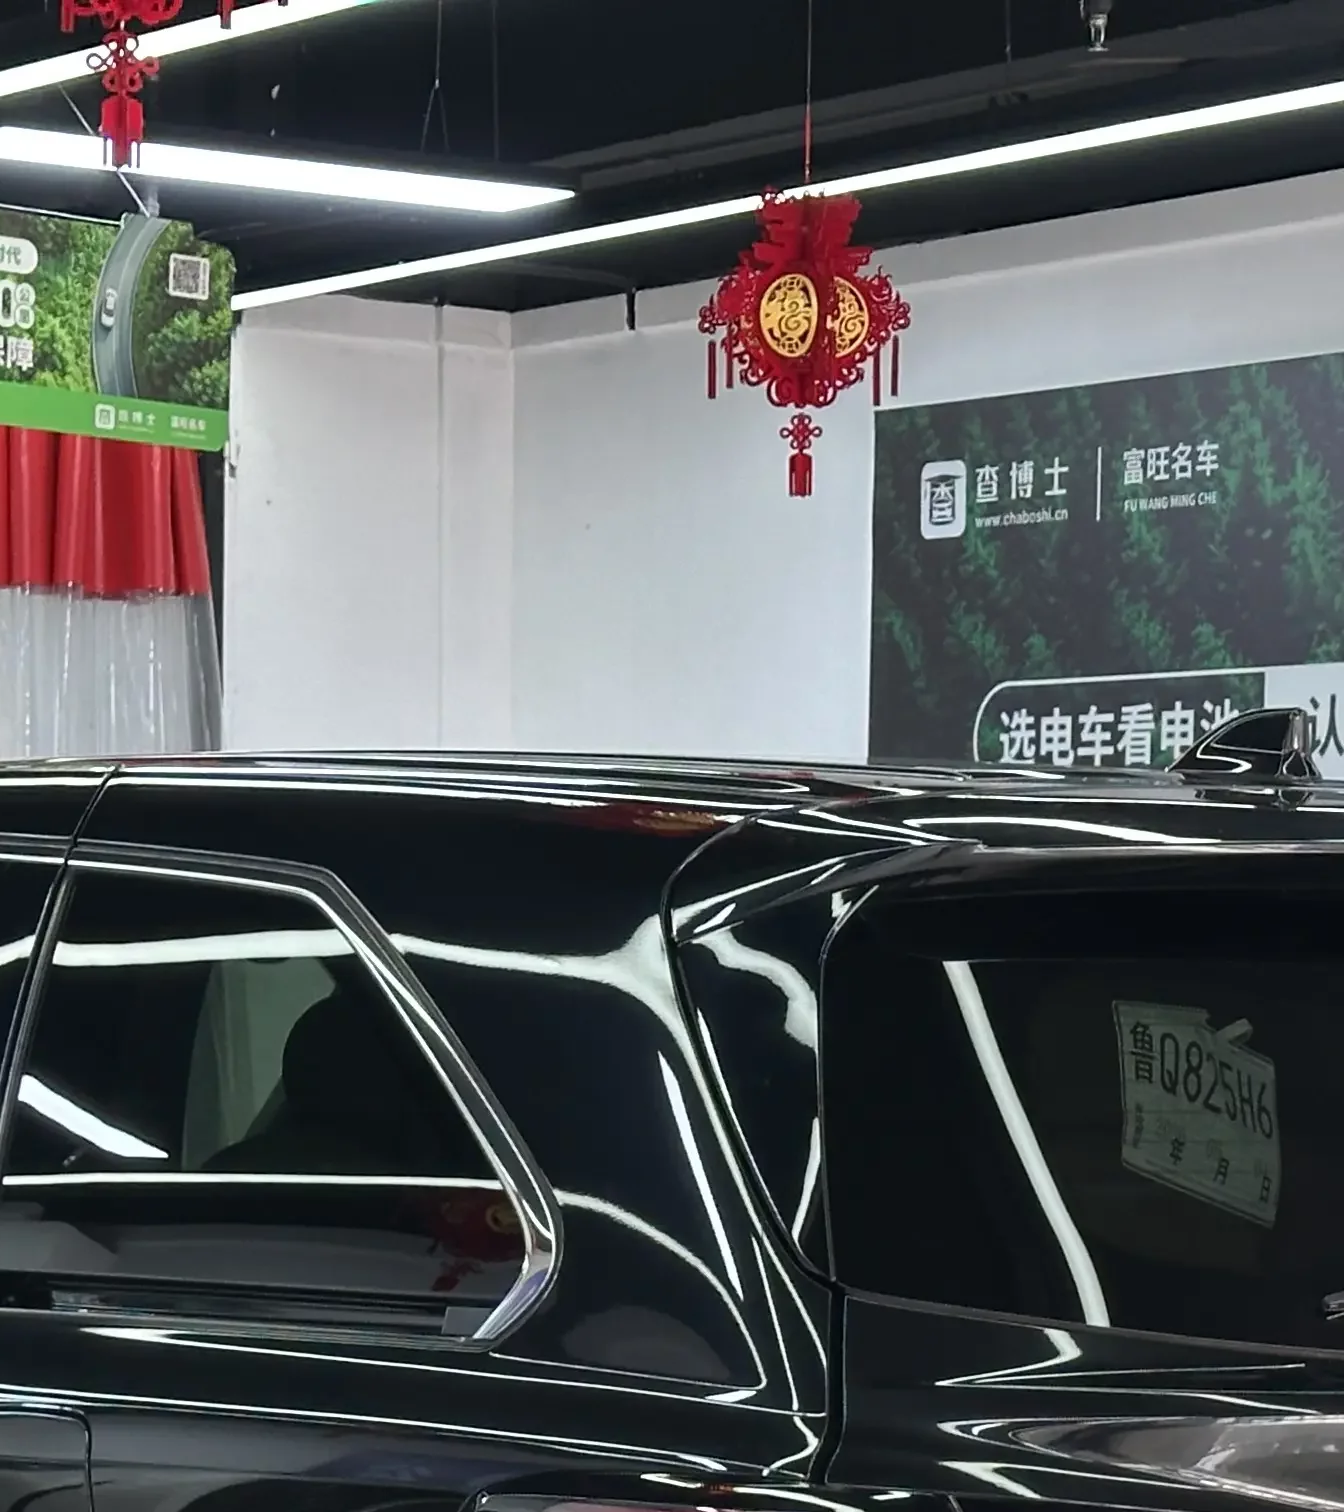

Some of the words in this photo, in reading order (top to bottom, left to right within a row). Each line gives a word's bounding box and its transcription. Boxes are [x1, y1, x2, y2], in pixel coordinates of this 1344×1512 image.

[974, 456, 1070, 504] 查博士
[1123, 440, 1220, 486] 富旺名车
[975, 506, 1068, 528] www.chaboshi.cn
